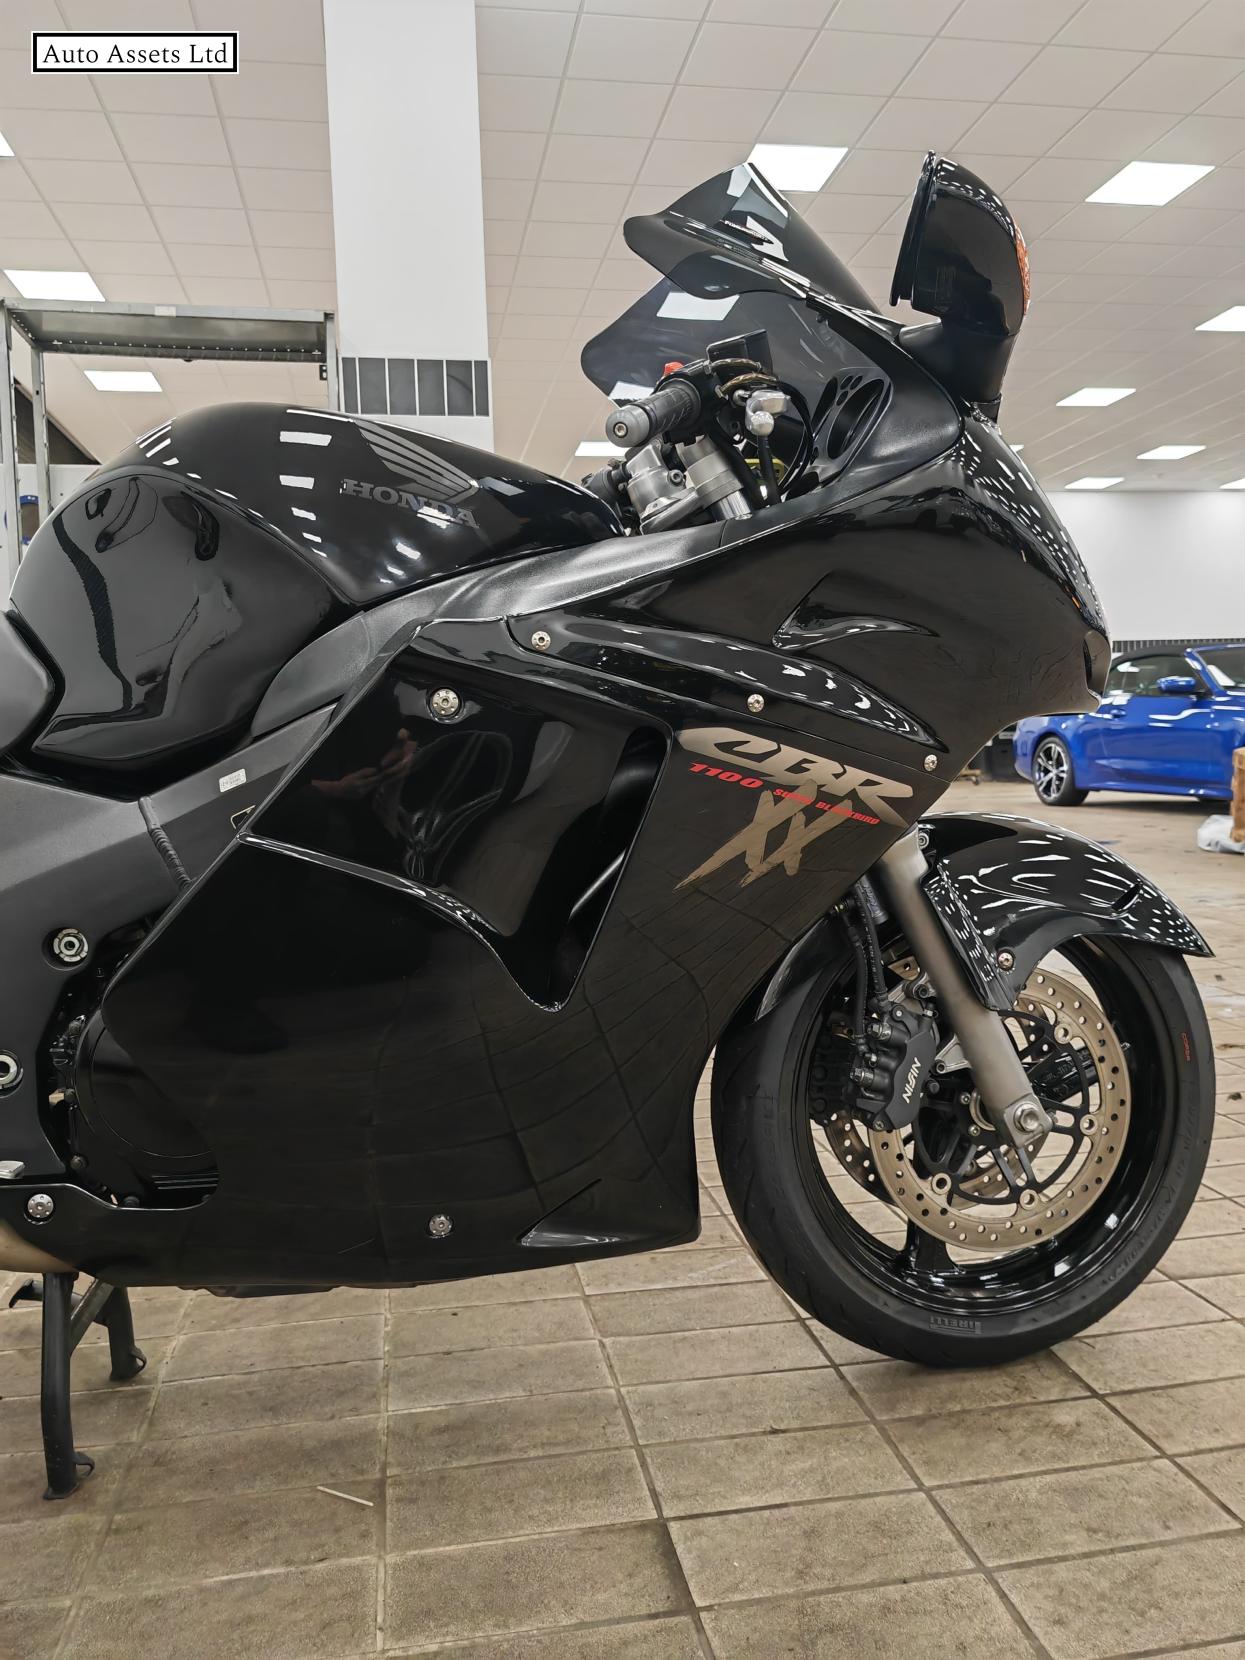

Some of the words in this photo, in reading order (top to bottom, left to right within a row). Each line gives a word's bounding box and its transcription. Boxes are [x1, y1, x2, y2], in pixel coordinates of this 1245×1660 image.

[341, 478, 480, 529] HONDA
[677, 727, 914, 828] CBR
[687, 762, 764, 789] 1100
[815, 801, 881, 825] BLBIRD
[672, 779, 853, 893] XX
[902, 1056, 922, 1104] NISSIN
[929, 1315, 982, 1335] PIRELLI
